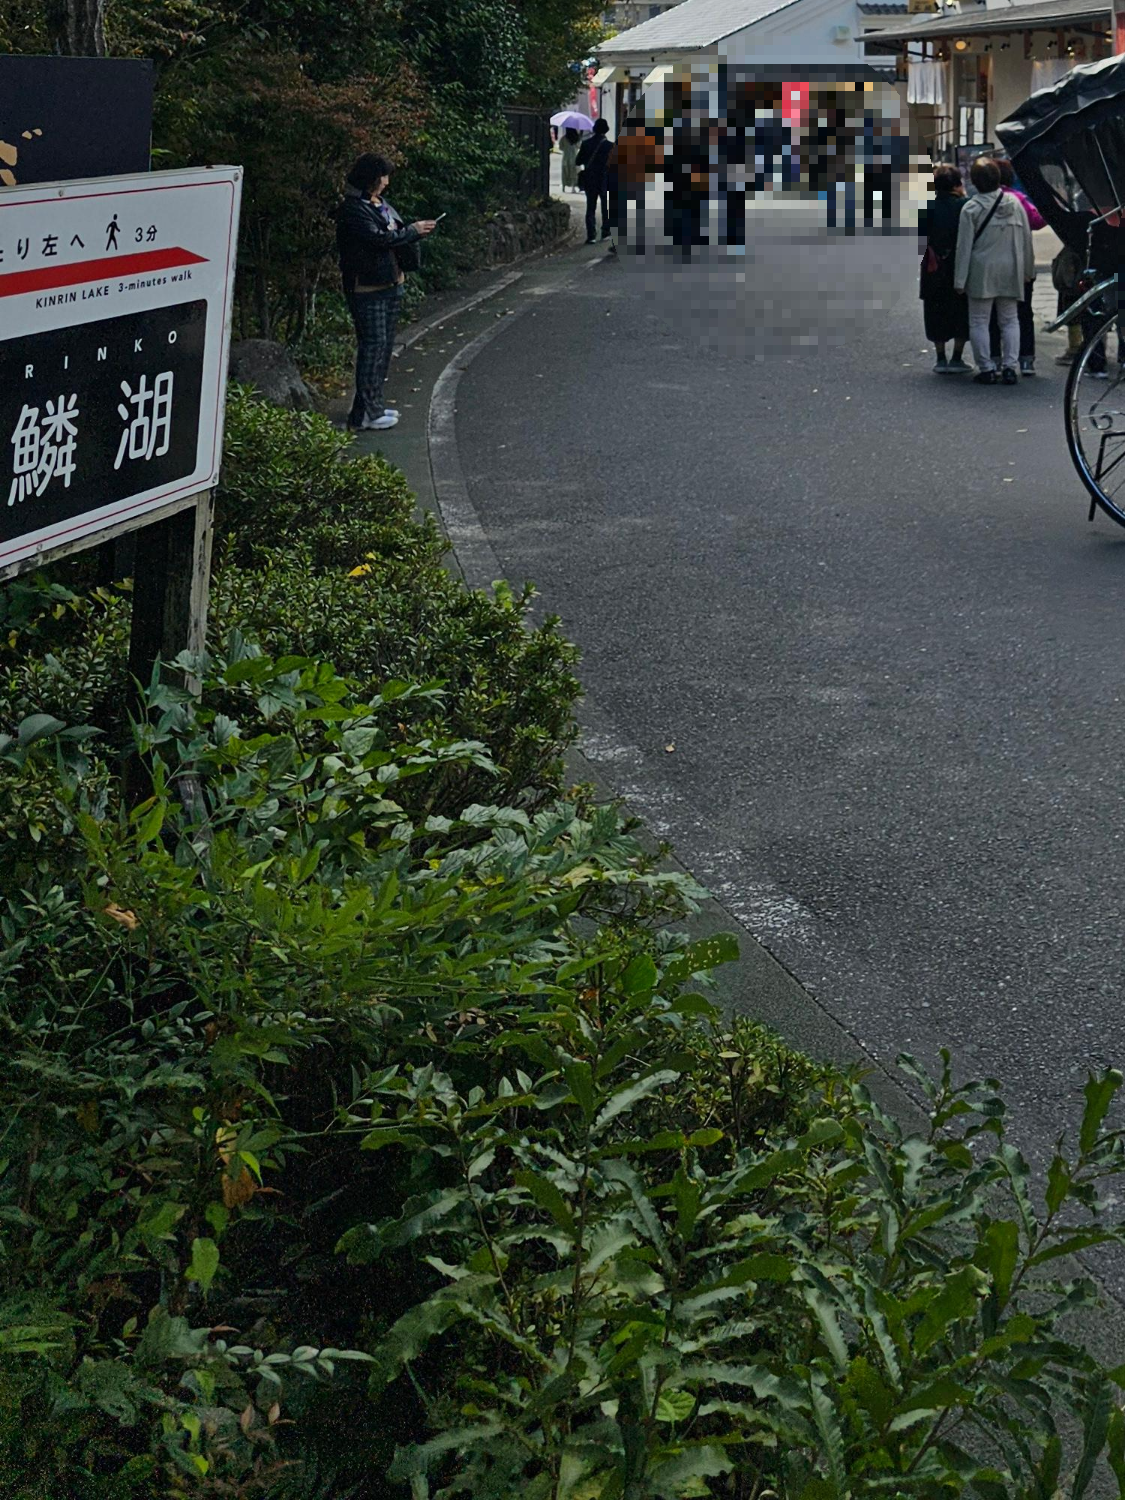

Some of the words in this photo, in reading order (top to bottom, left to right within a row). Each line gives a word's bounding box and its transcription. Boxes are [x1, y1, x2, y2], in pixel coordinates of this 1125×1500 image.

[0, 234, 85, 262] り左へ
[134, 224, 158, 242] 3分
[35, 291, 77, 309] KINRIN
[82, 285, 110, 301] LAKE
[118, 277, 167, 293] 3-minutes
[171, 269, 193, 283] walk
[7, 370, 174, 507] 鱗湖
